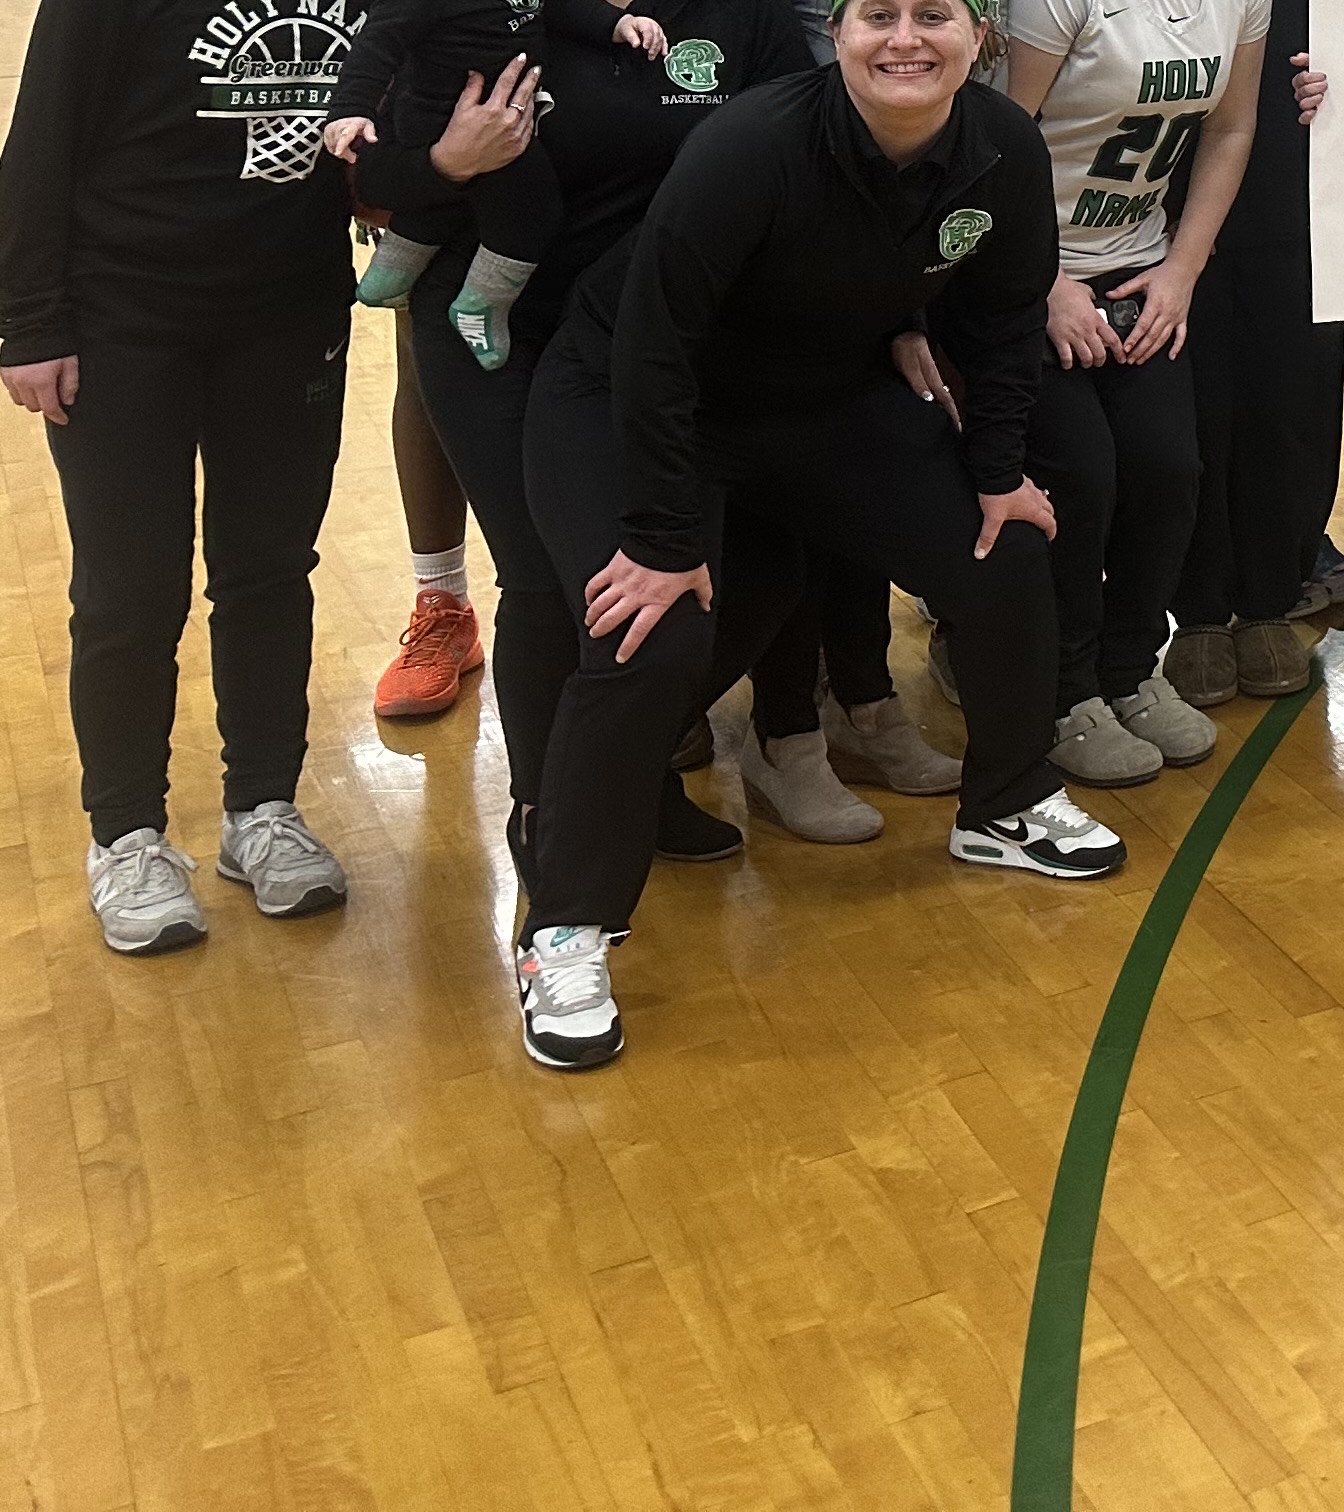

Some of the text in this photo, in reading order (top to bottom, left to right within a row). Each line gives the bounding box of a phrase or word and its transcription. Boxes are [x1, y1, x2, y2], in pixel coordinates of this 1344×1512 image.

[229, 54, 341, 83] Greenwa
[1137, 56, 1222, 105] HOLY
[1087, 109, 1209, 183] 20
[457, 312, 489, 350] NIKE
